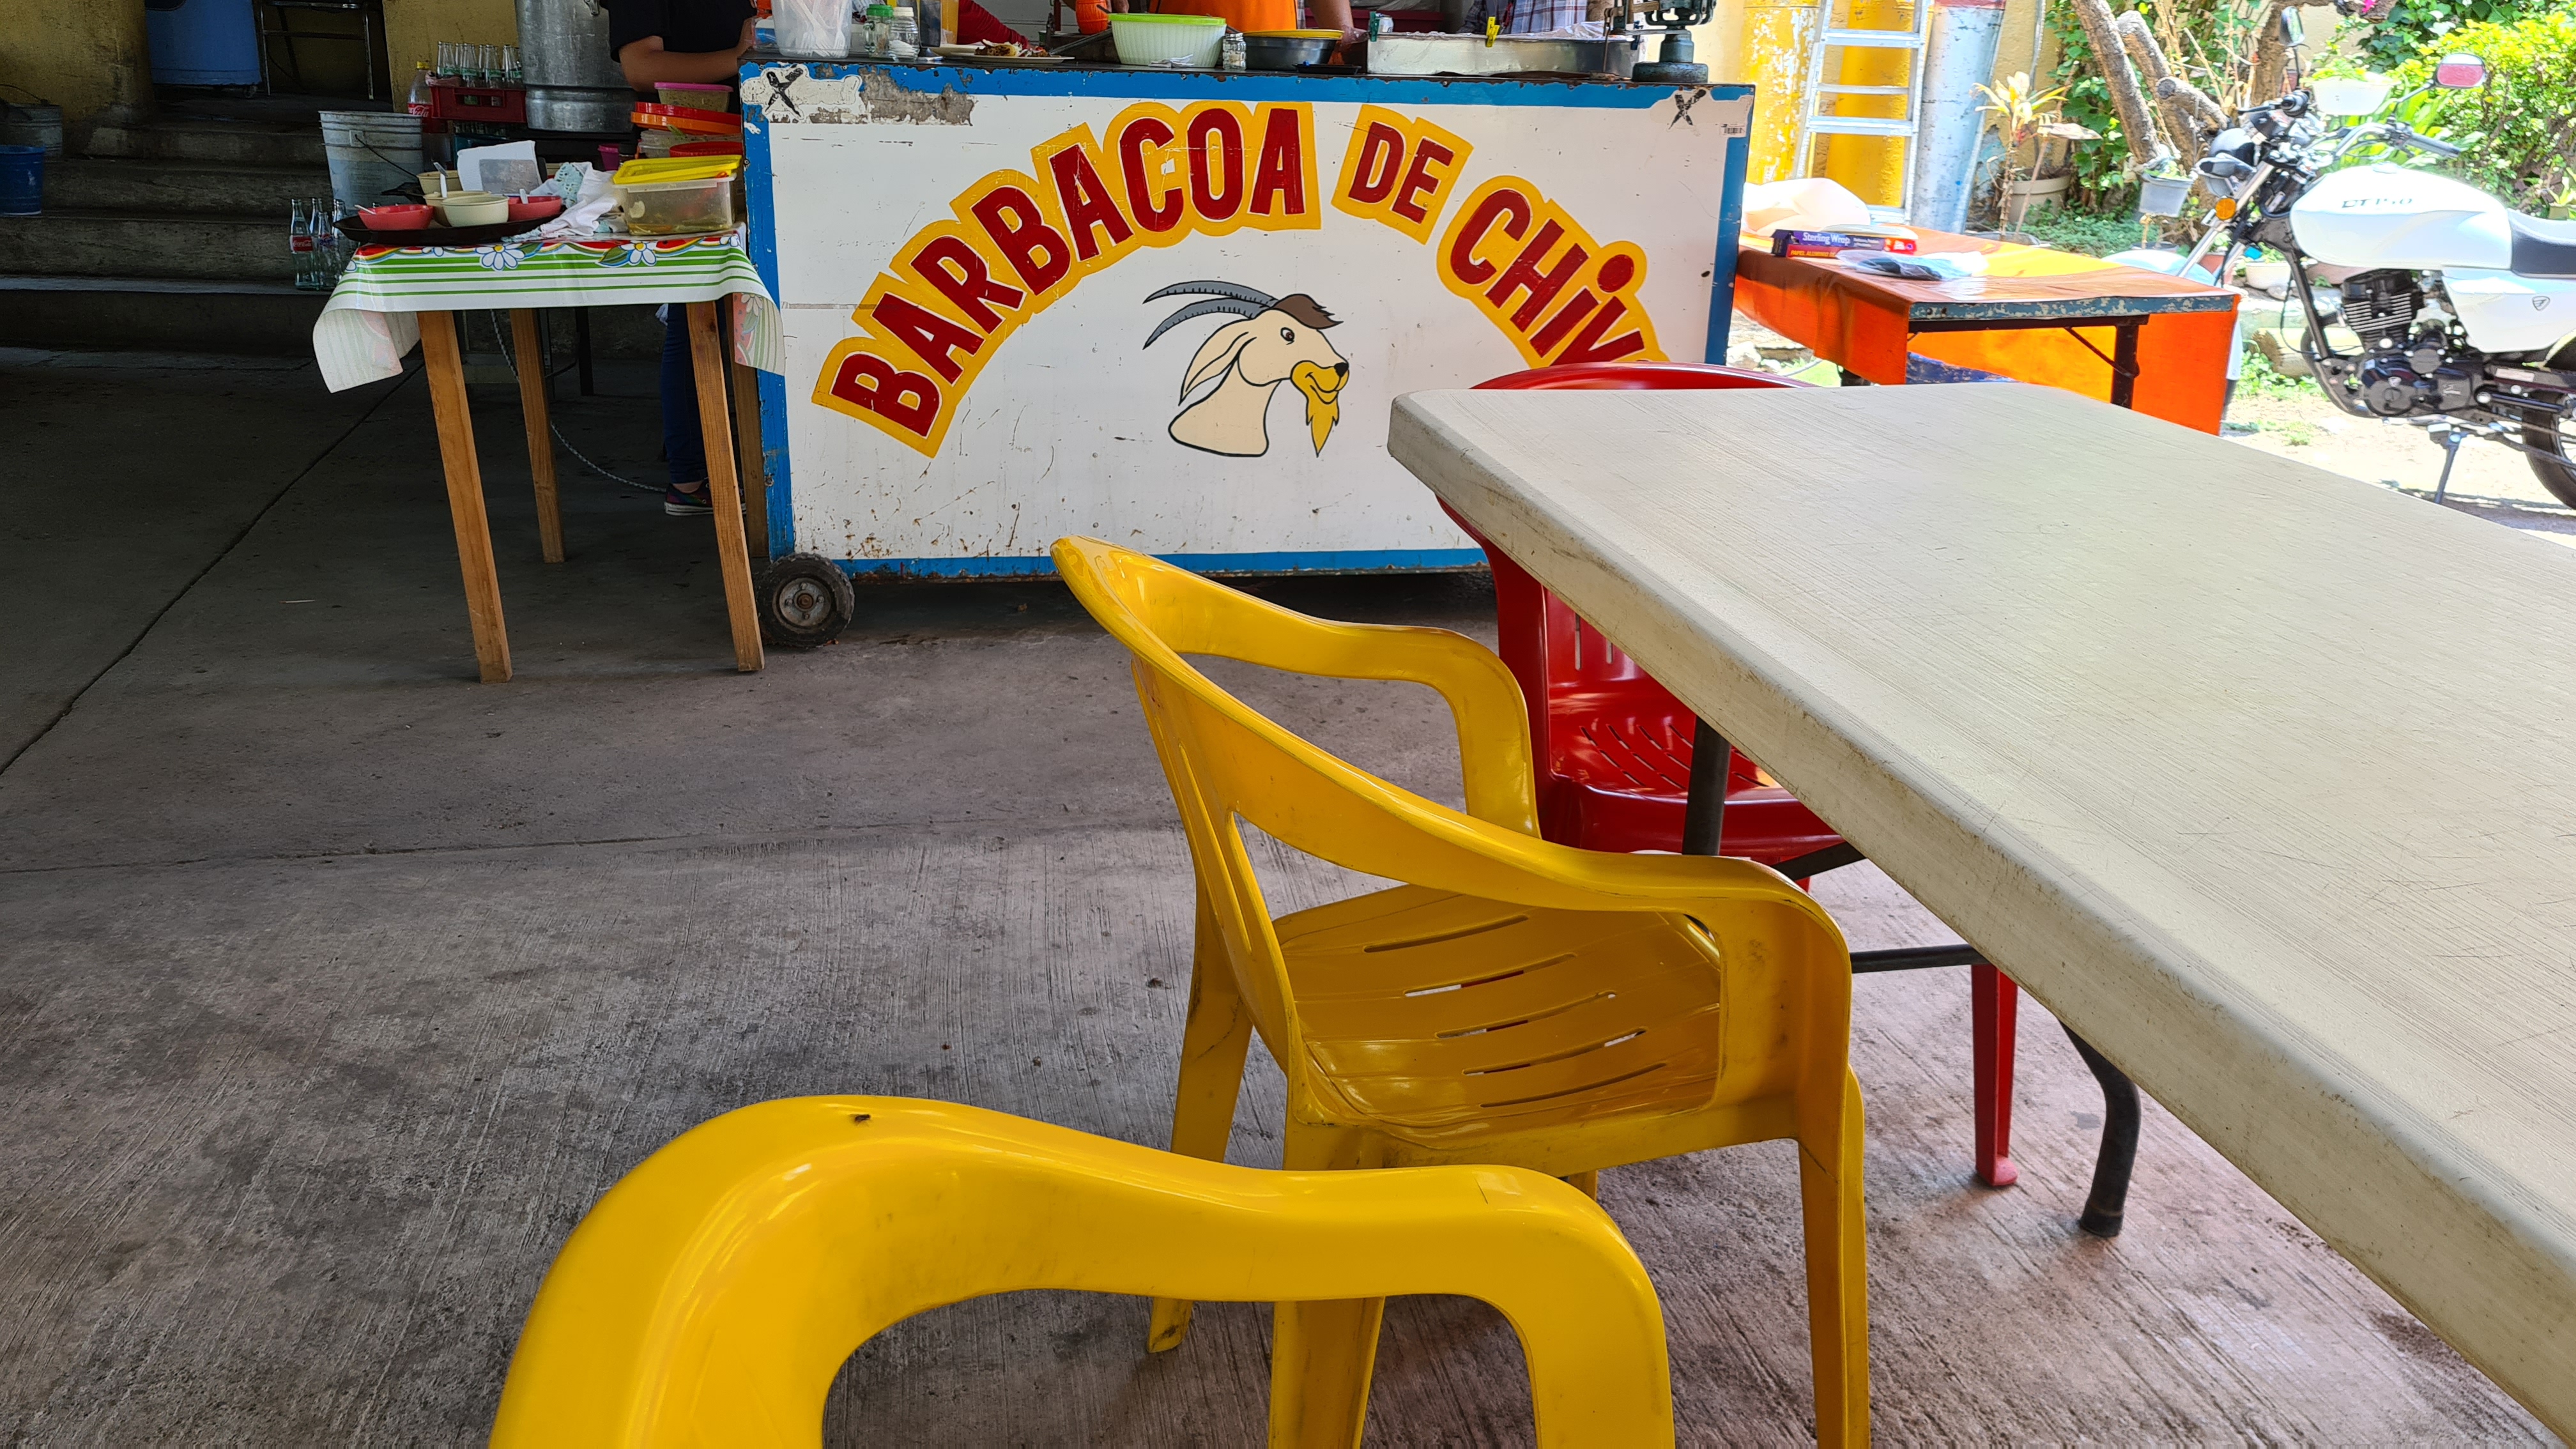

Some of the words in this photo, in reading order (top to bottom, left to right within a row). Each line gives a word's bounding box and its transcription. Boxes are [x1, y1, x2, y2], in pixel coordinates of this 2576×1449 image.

[831, 107, 1306, 438] BARBACOA
[1347, 121, 1455, 224] DE
[1450, 188, 1646, 367] CHiV
[1802, 232, 1831, 245] Sterling
[1830, 233, 1851, 247] Wrap
